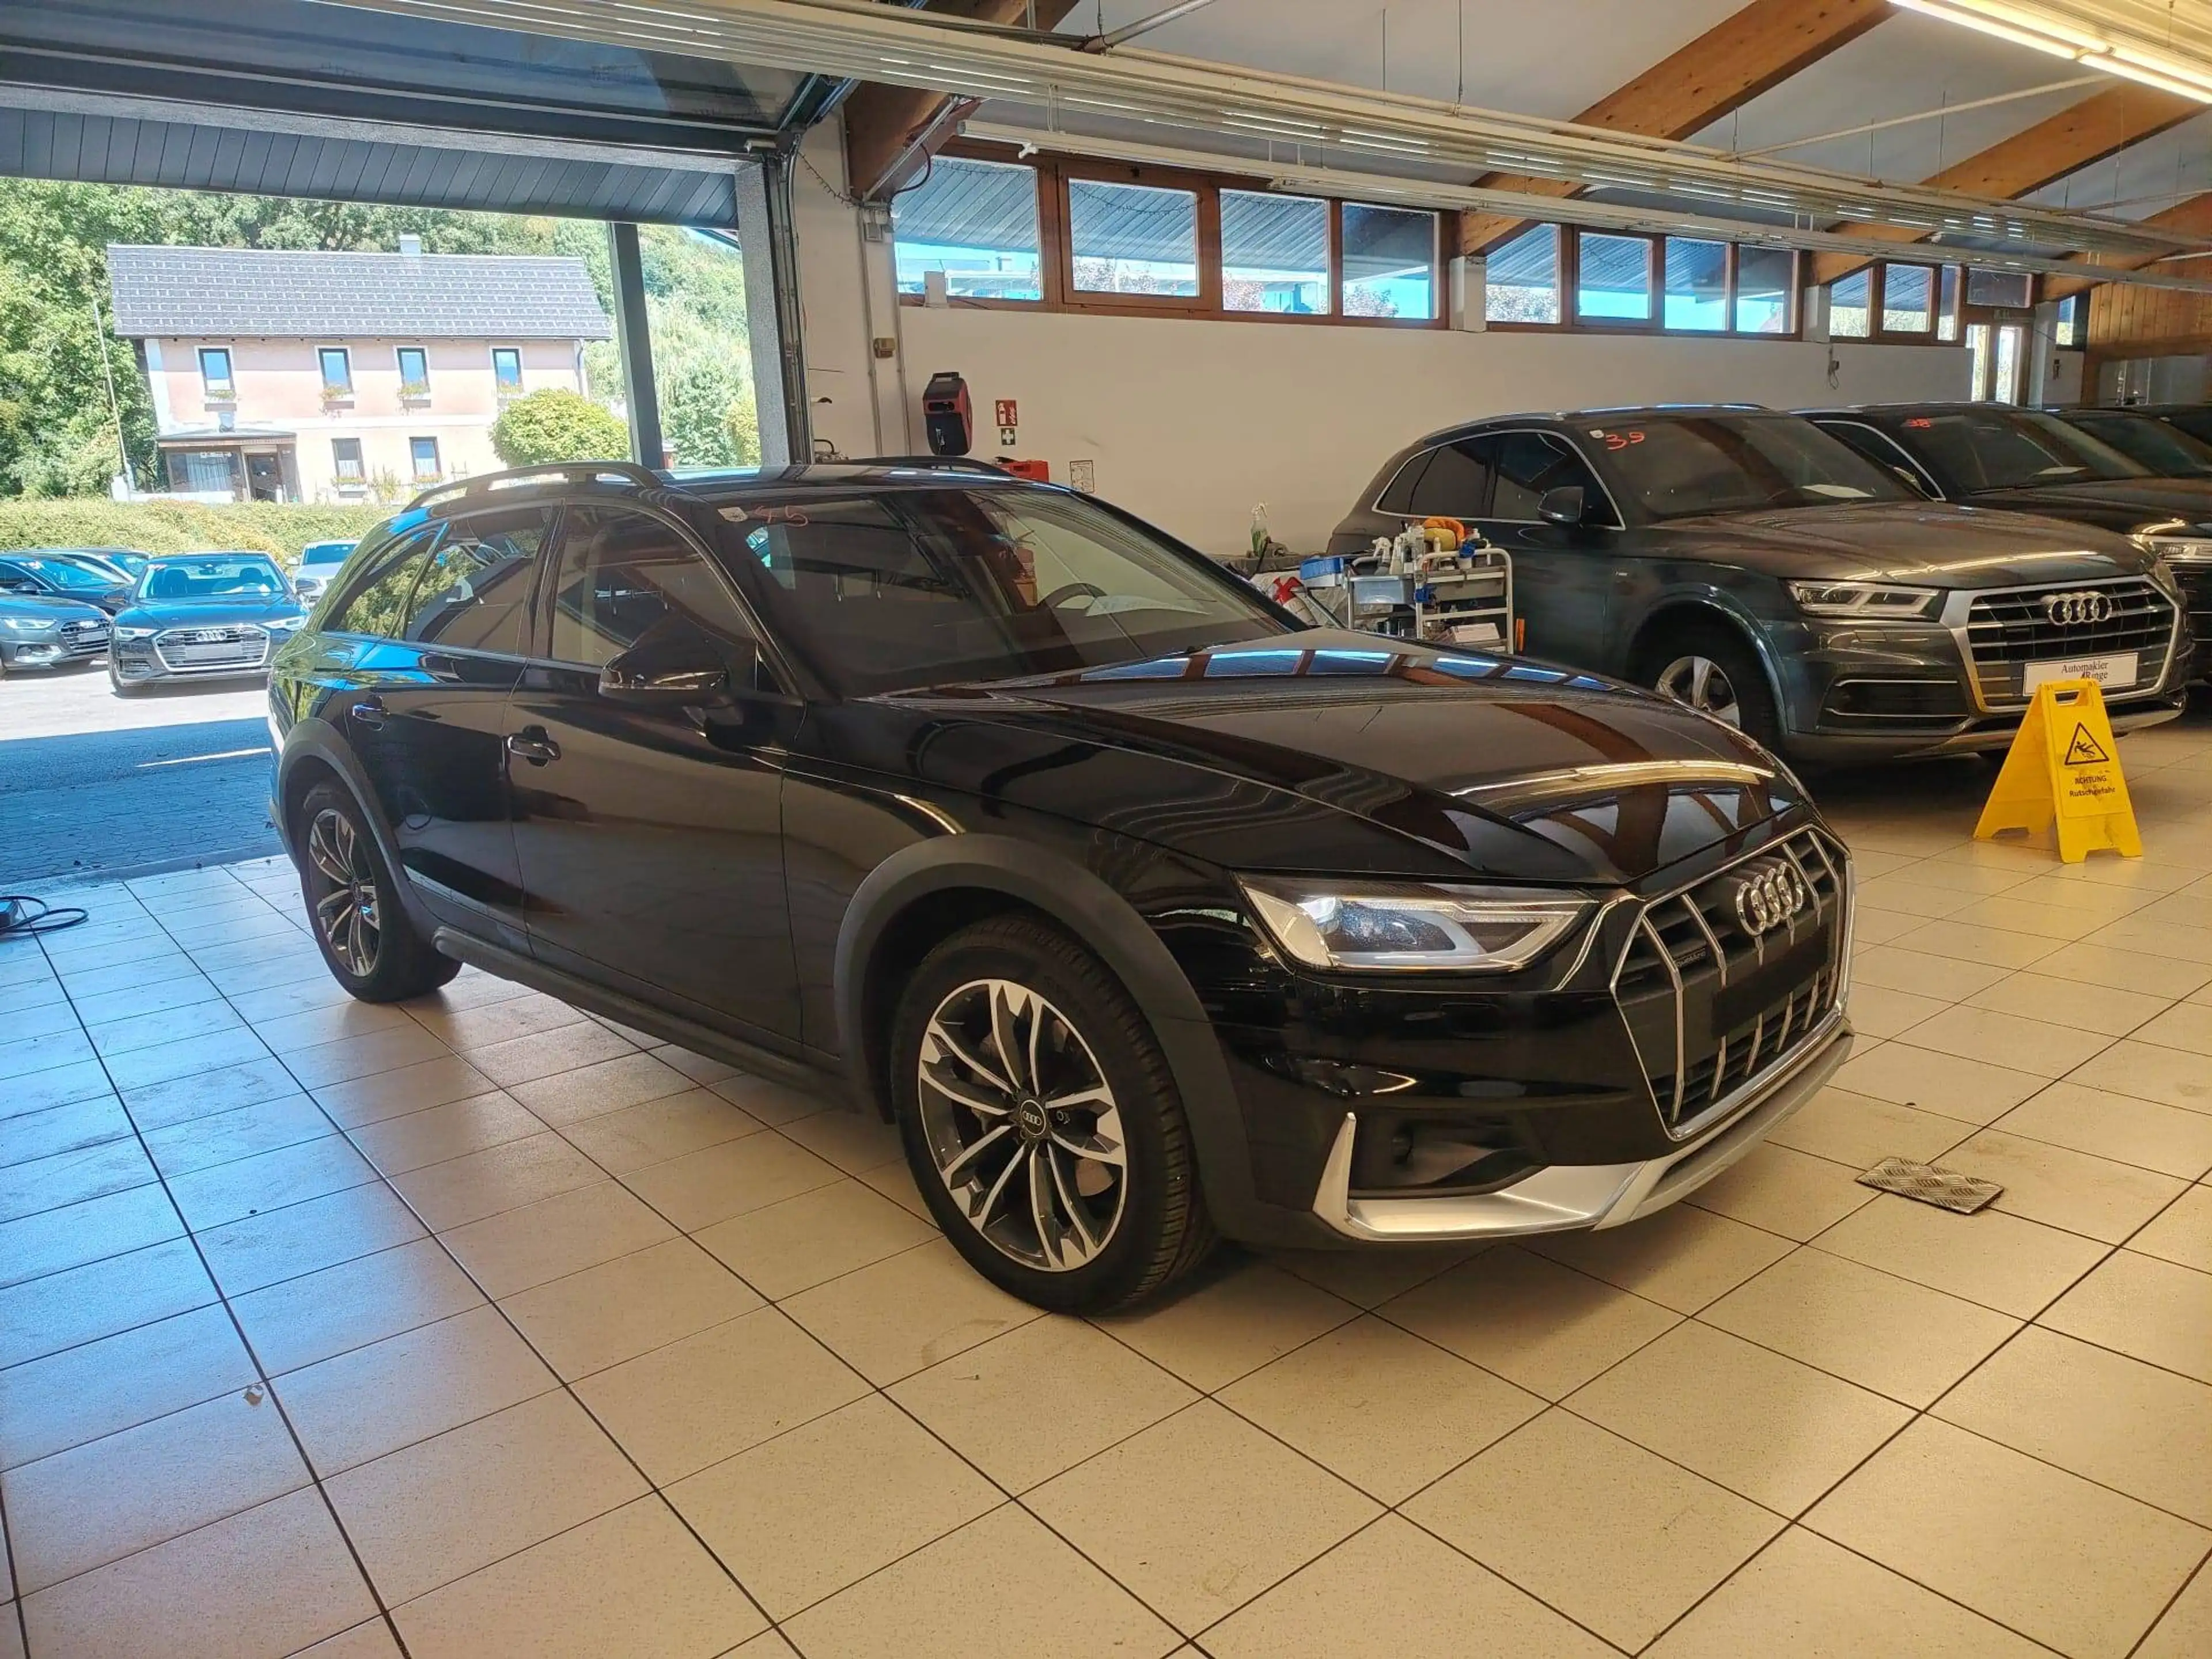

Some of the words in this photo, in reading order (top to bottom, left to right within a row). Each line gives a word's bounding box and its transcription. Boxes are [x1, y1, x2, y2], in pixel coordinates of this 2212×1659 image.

[1605, 432, 1645, 450] 39
[2061, 661, 2109, 675] Automakler
[2075, 775, 2107, 784] ACHTUNG
